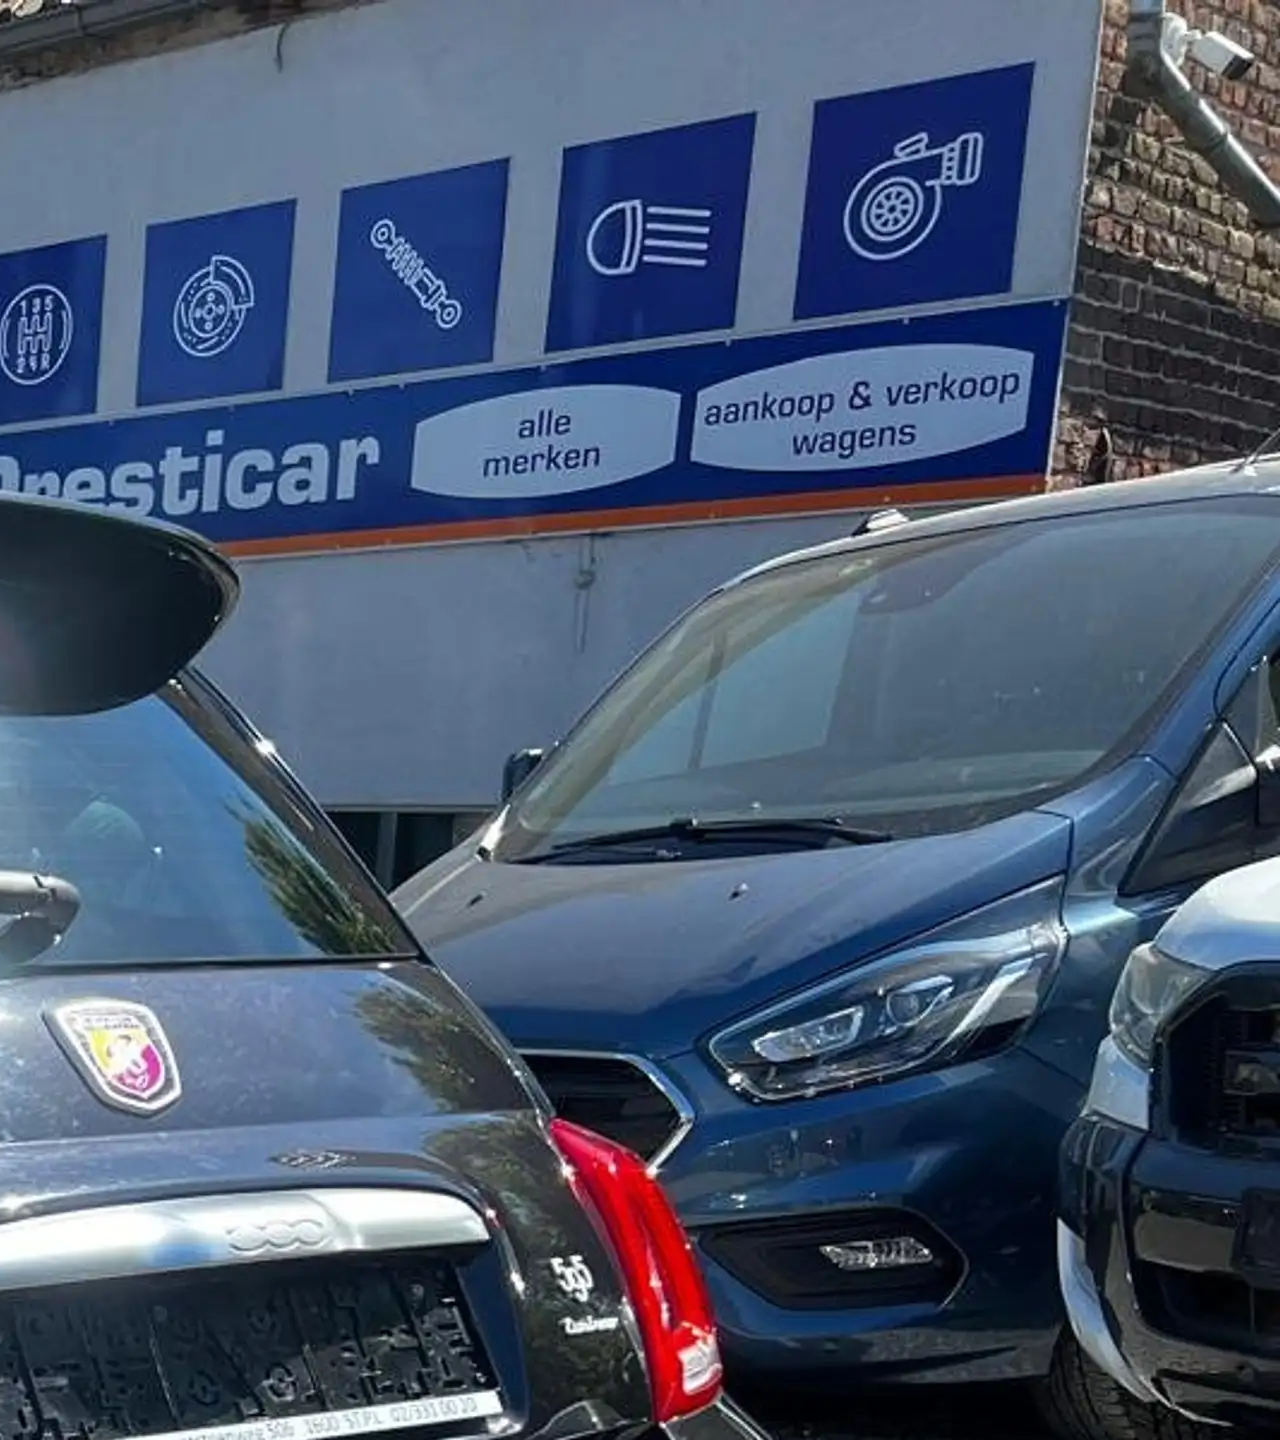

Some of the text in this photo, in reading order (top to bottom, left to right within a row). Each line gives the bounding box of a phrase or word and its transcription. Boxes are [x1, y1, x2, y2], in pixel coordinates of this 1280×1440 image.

[704, 369, 1022, 426] aankoop & verkoop
[517, 409, 572, 439] alle
[791, 421, 917, 457] wagens
[482, 444, 601, 478] merken
